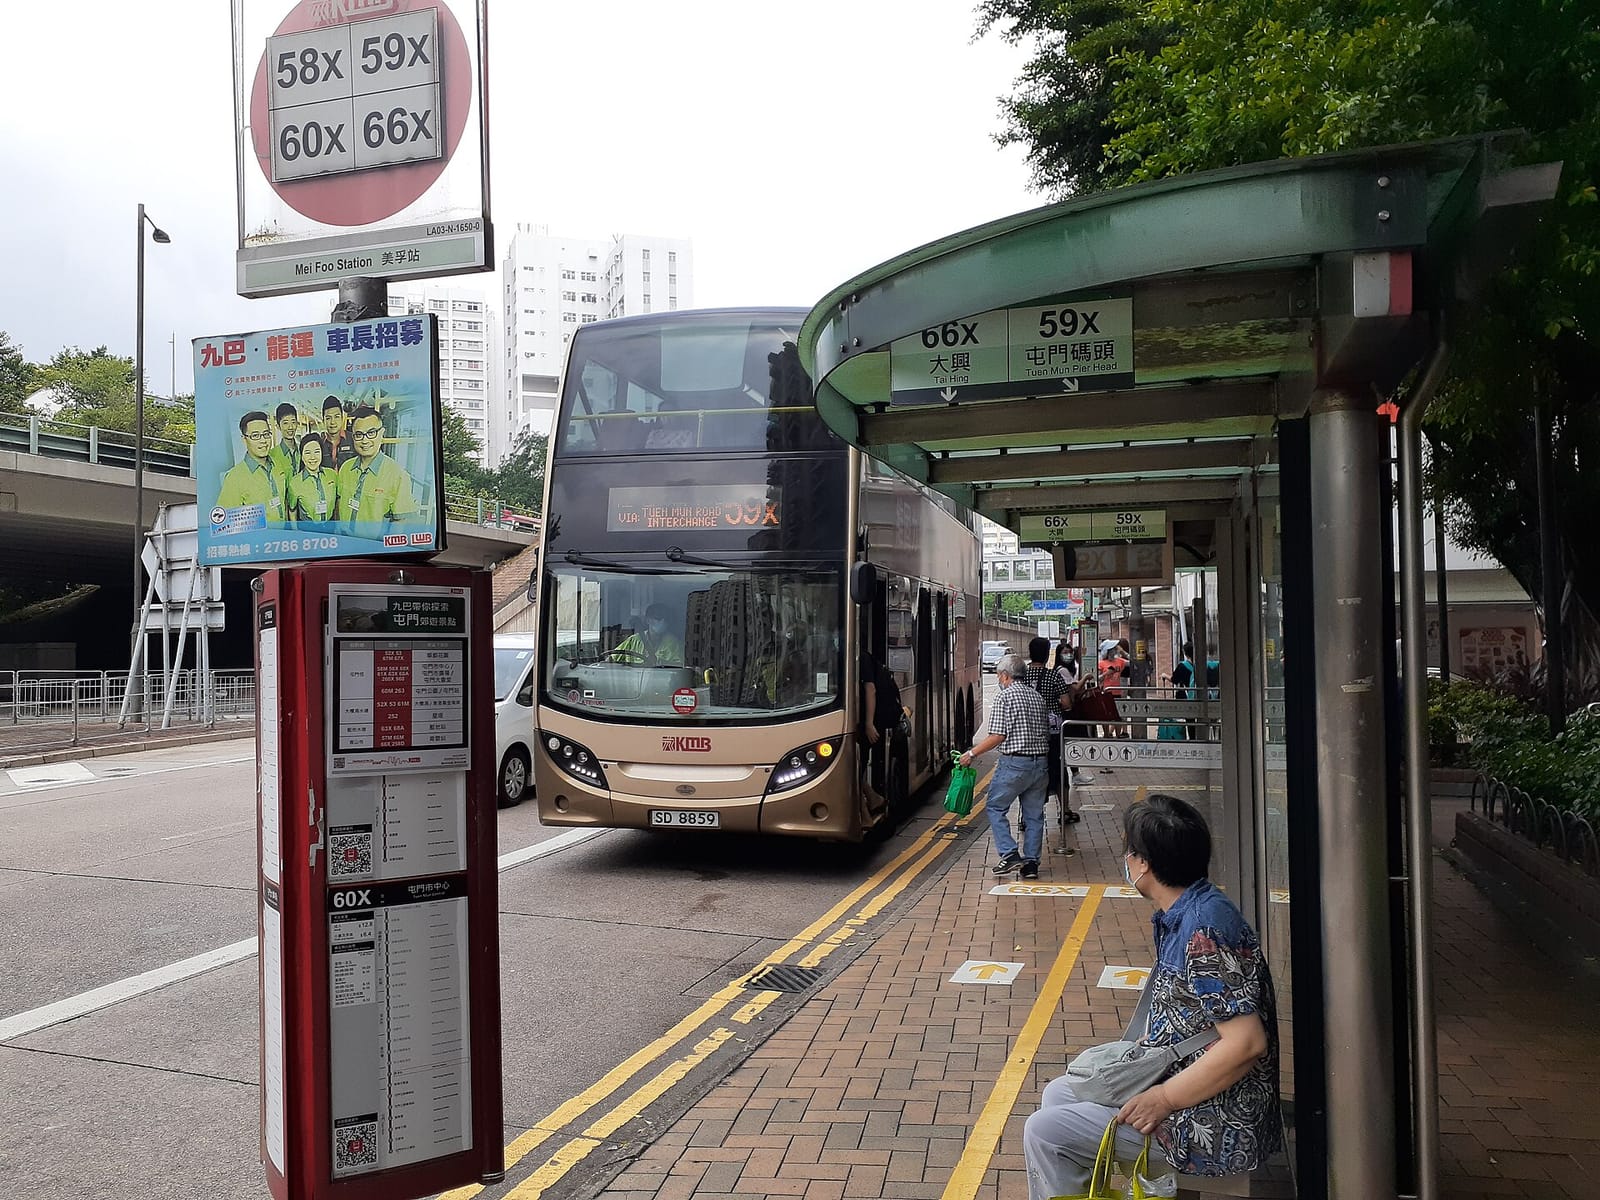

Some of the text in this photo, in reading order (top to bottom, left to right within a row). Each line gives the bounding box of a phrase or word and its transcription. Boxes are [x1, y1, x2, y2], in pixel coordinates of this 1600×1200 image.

[361, 33, 431, 75] 59X
[277, 48, 344, 89] 58X
[363, 107, 433, 149] 66X
[280, 121, 347, 162] 60X
[426, 222, 480, 237] LA03-N-1650-0
[295, 256, 373, 276] Mei Foo Station
[381, 249, 421, 266] 美孚站
[1039, 308, 1101, 338] 59X
[326, 318, 424, 354] 車長招募
[921, 320, 980, 349] 66X
[1025, 340, 1115, 366] 屯門碼頭
[929, 352, 971, 375] 大興
[1025, 361, 1118, 377] Tuen Mun Pier Head
[934, 374, 969, 385] Tai Hing
[695, 506, 722, 518] ROAD
[1116, 513, 1142, 525] 59X
[647, 516, 718, 528] INTERCHANGE
[1044, 516, 1069, 528] 66X
[264, 540, 299, 554] 2786
[302, 537, 338, 551] 8708
[384, 533, 433, 547] KMB LWB
[675, 736, 712, 752] KMB
[655, 812, 716, 826] SD 8859
[333, 889, 372, 908] 60X
[1008, 885, 1075, 895] 66X
